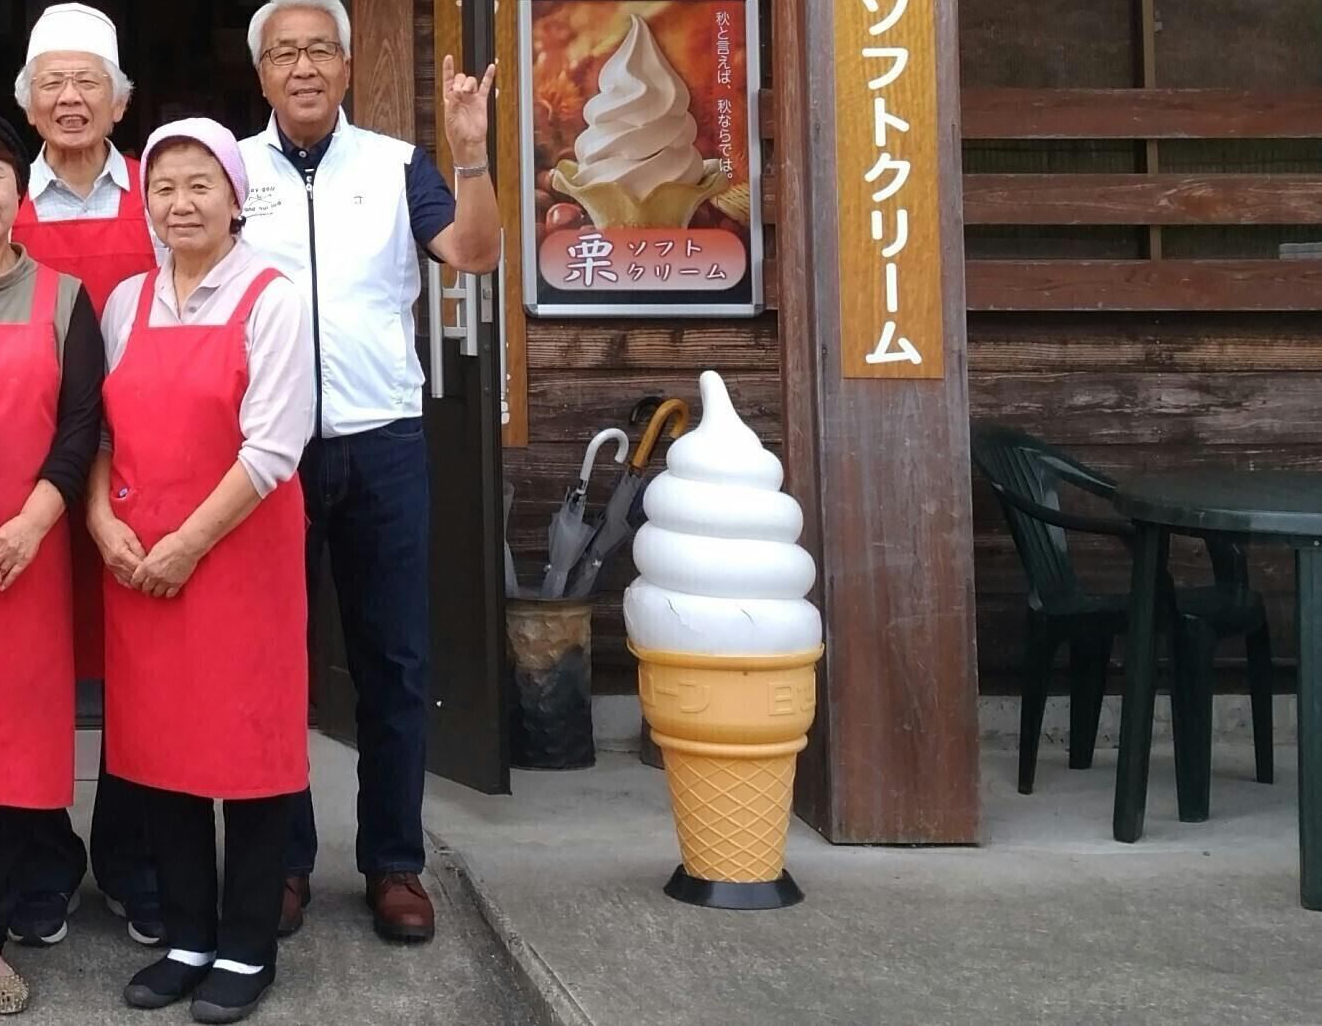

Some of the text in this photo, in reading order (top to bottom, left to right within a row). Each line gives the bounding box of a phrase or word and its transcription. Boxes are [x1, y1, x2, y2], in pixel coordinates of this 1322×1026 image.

[627, 239, 702, 258] ソフト
[565, 232, 618, 287] 栗
[627, 263, 727, 281] クリーム
